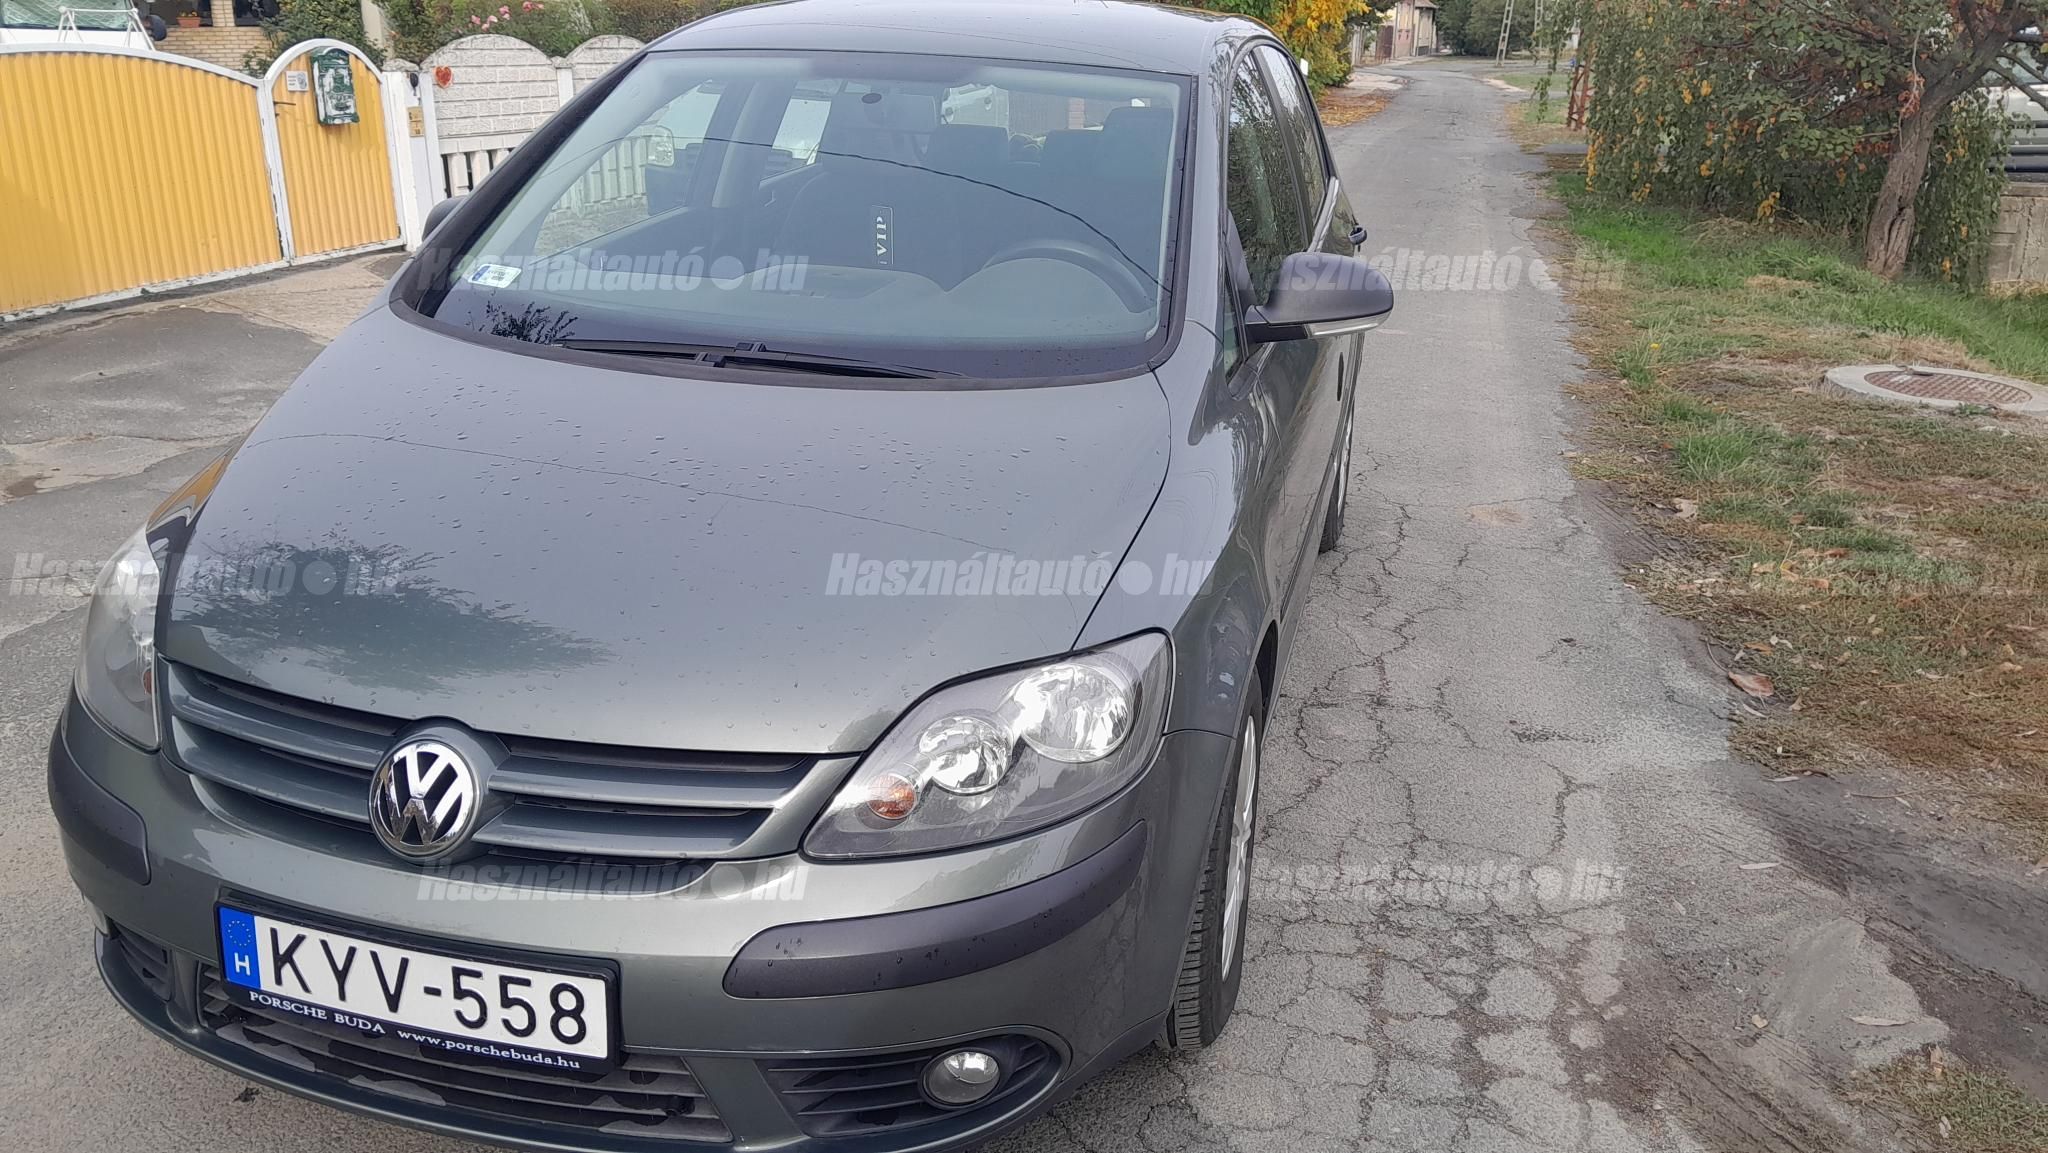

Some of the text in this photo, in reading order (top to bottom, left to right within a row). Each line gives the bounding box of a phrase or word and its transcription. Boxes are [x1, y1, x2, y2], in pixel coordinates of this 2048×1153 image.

[876, 216, 888, 257] VIP
[269, 927, 587, 1045] KYV-558
[249, 991, 581, 1069] PORSCHE BUDA www.porschebuda.hu
